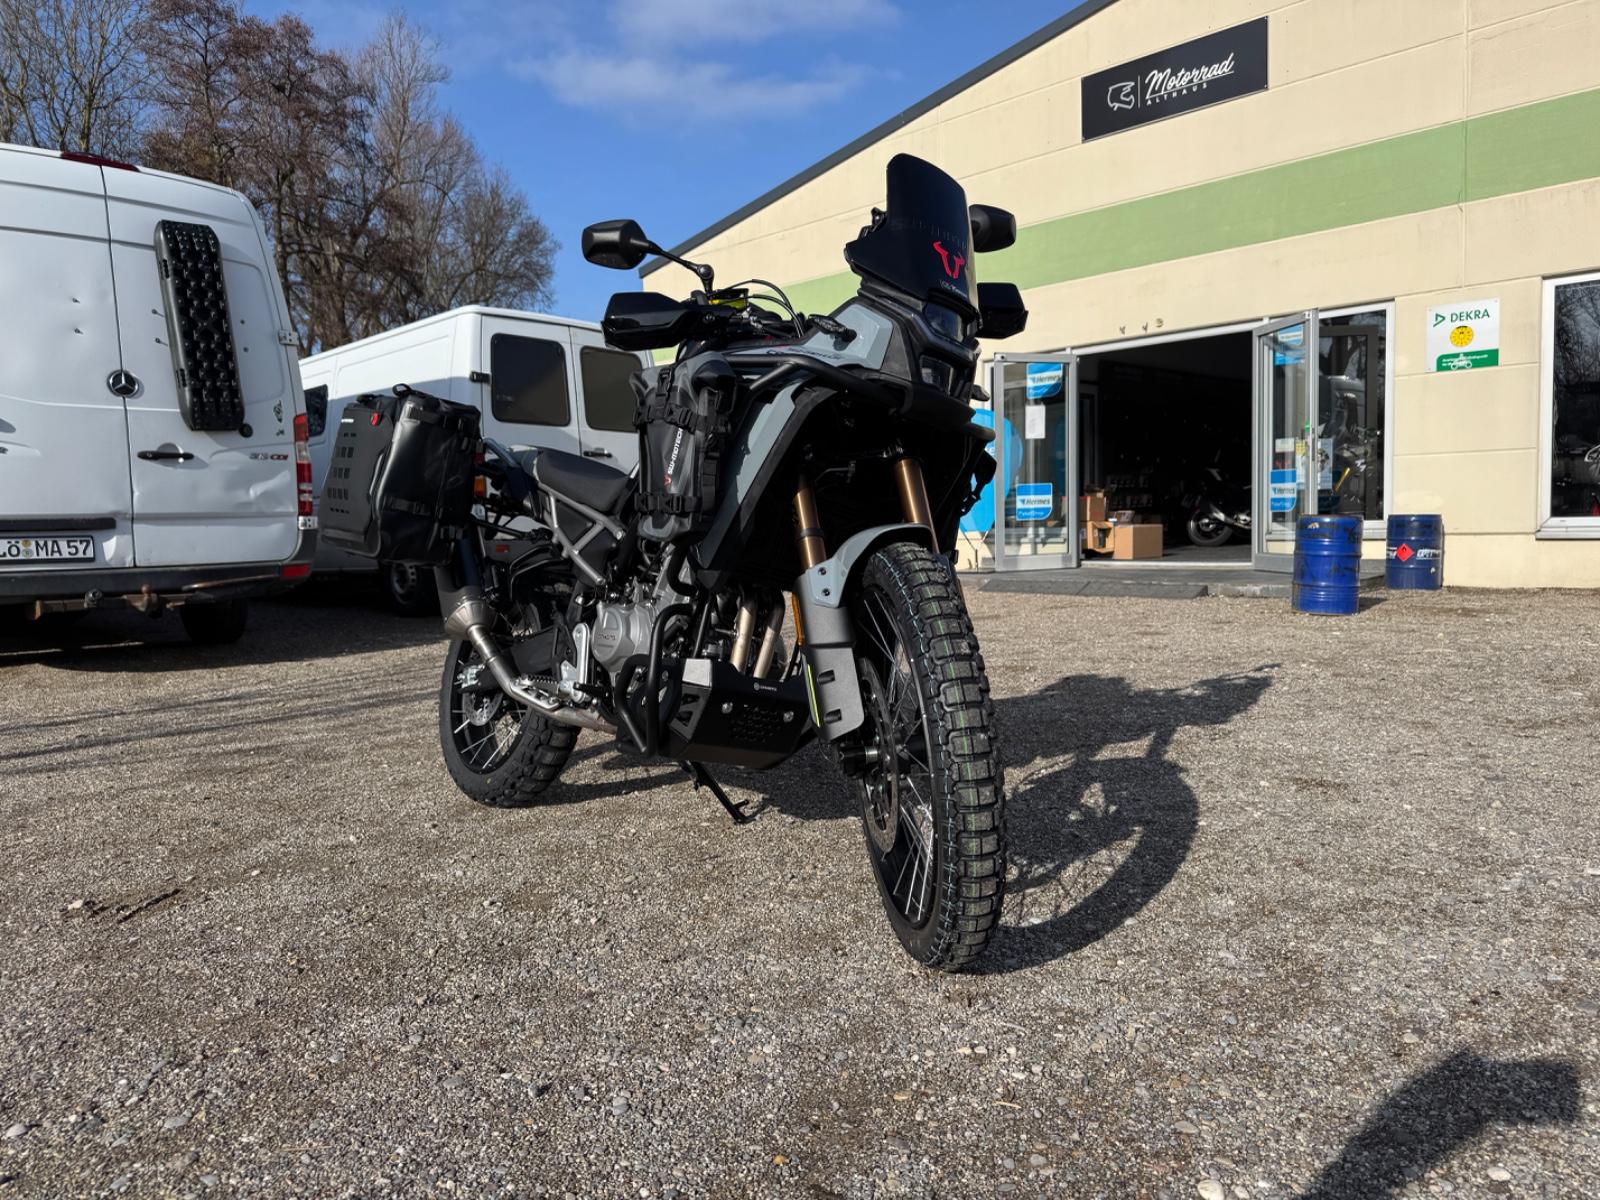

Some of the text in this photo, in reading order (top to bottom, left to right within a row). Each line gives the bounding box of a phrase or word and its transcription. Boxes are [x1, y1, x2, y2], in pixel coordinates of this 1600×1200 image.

[1145, 52, 1235, 100] Motorrad
[1146, 82, 1208, 106] ALTHAUS
[1450, 308, 1490, 323] DEKRA
[35, 539, 63, 557] MA
[66, 539, 91, 556] 57
